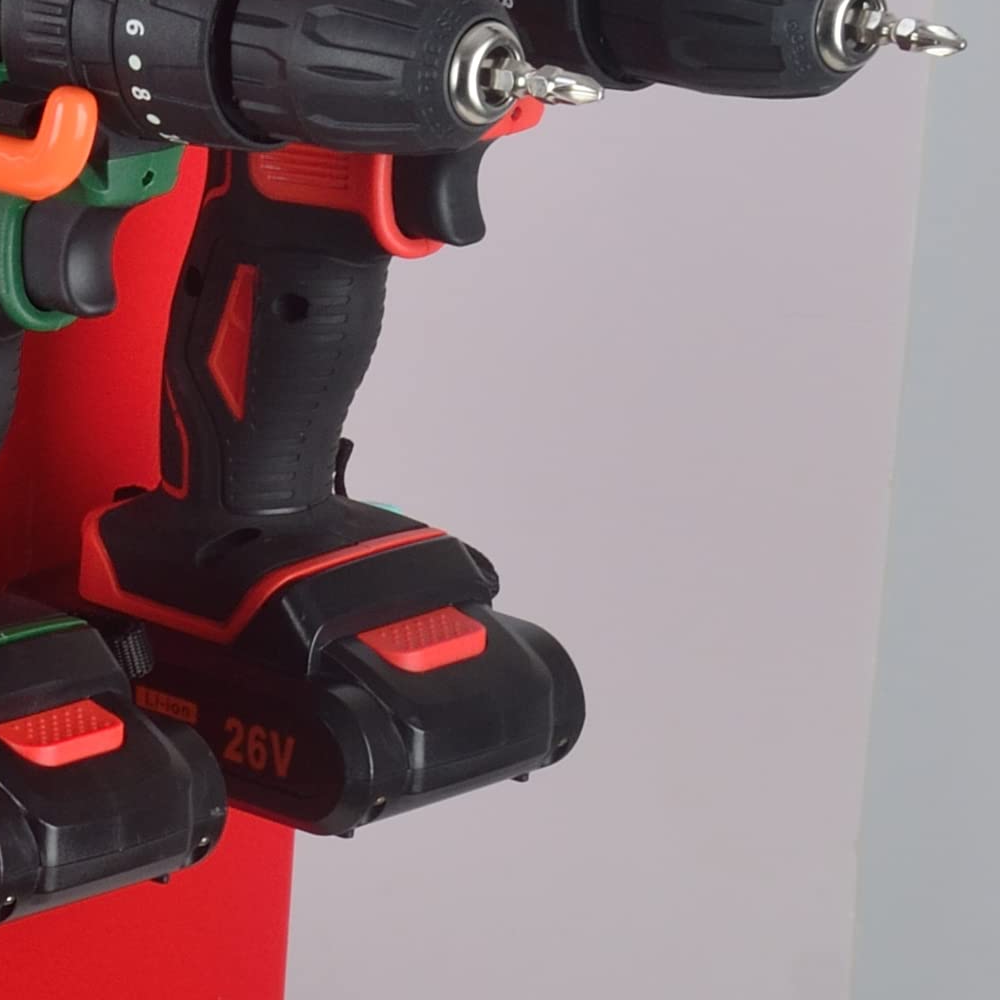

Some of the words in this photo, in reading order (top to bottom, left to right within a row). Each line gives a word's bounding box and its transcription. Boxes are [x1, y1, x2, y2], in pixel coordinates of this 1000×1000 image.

[126, 18, 145, 37] 6
[131, 85, 152, 101] 8
[223, 717, 296, 777] 26V
